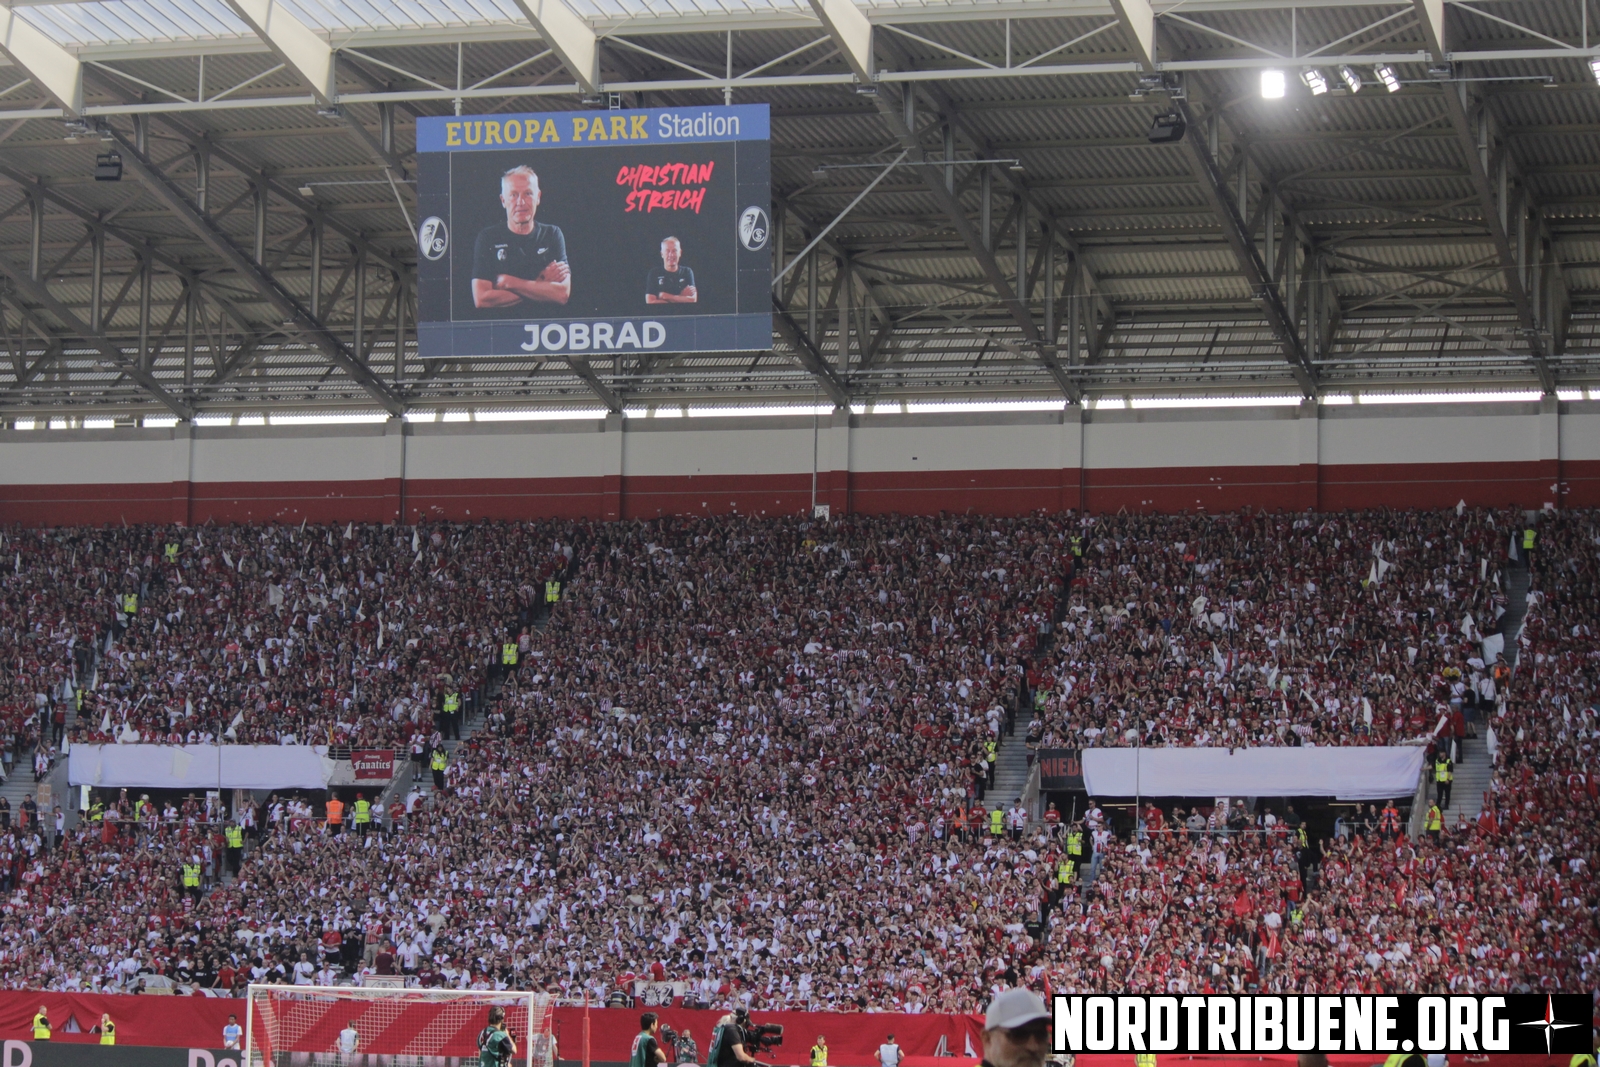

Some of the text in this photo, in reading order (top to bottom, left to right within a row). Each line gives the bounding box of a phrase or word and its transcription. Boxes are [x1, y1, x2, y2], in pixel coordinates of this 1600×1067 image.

[446, 113, 740, 146] EUROPA PARK Stadion
[616, 161, 715, 189] CHRISTIAN
[625, 187, 706, 214] STREICH
[520, 321, 667, 351] JOBRAD
[353, 759, 392, 771] Fanatics
[1041, 757, 1084, 778] NIED
